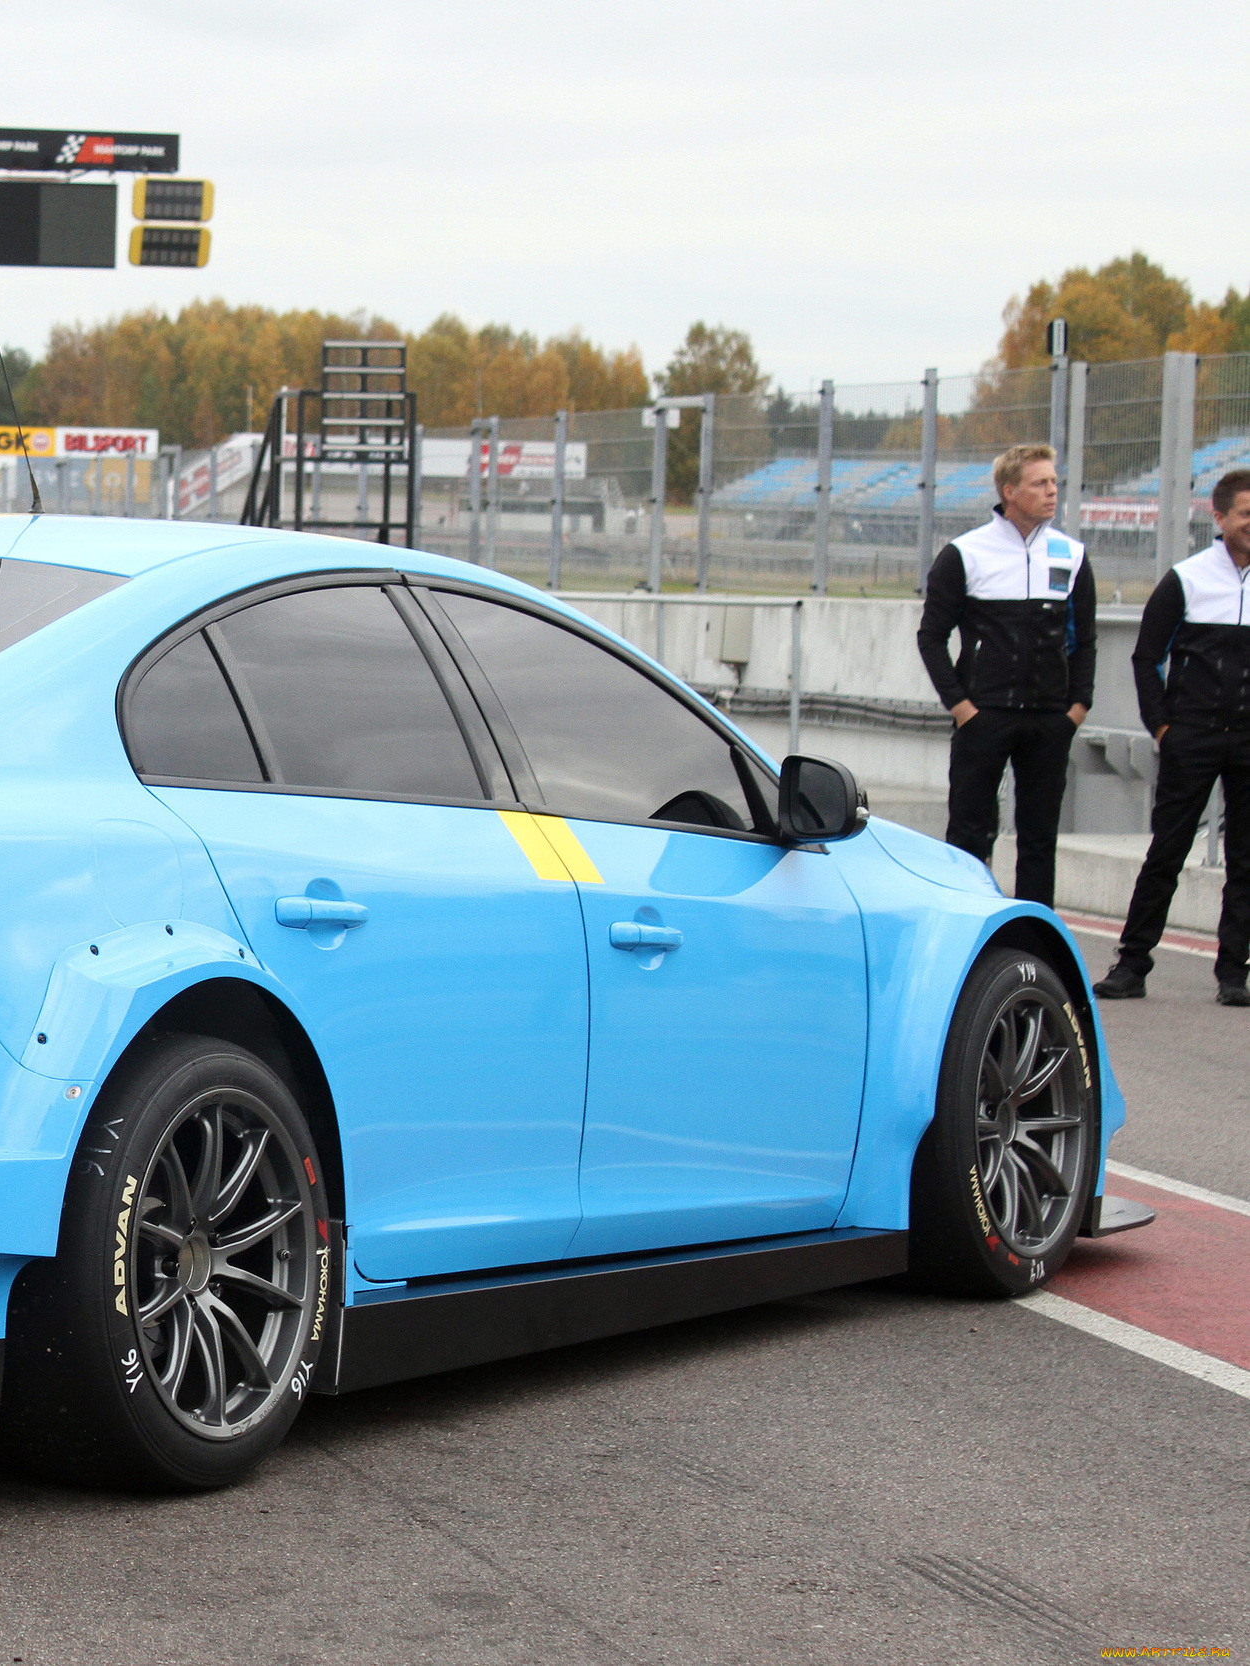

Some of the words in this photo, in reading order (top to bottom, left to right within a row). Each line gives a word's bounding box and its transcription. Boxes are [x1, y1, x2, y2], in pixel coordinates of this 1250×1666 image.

[14, 141, 39, 152] PARK
[140, 145, 166, 157] PARK
[64, 434, 148, 453] BILSPORT
[1062, 1001, 1092, 1089] ADVAN
[969, 1164, 991, 1237] YOKOHAMA
[113, 1174, 138, 1317] ADVAN
[310, 1246, 331, 1342] YOKOHAMA
[291, 1360, 314, 1400] Y16
[258, 1393, 282, 1420] RACING
